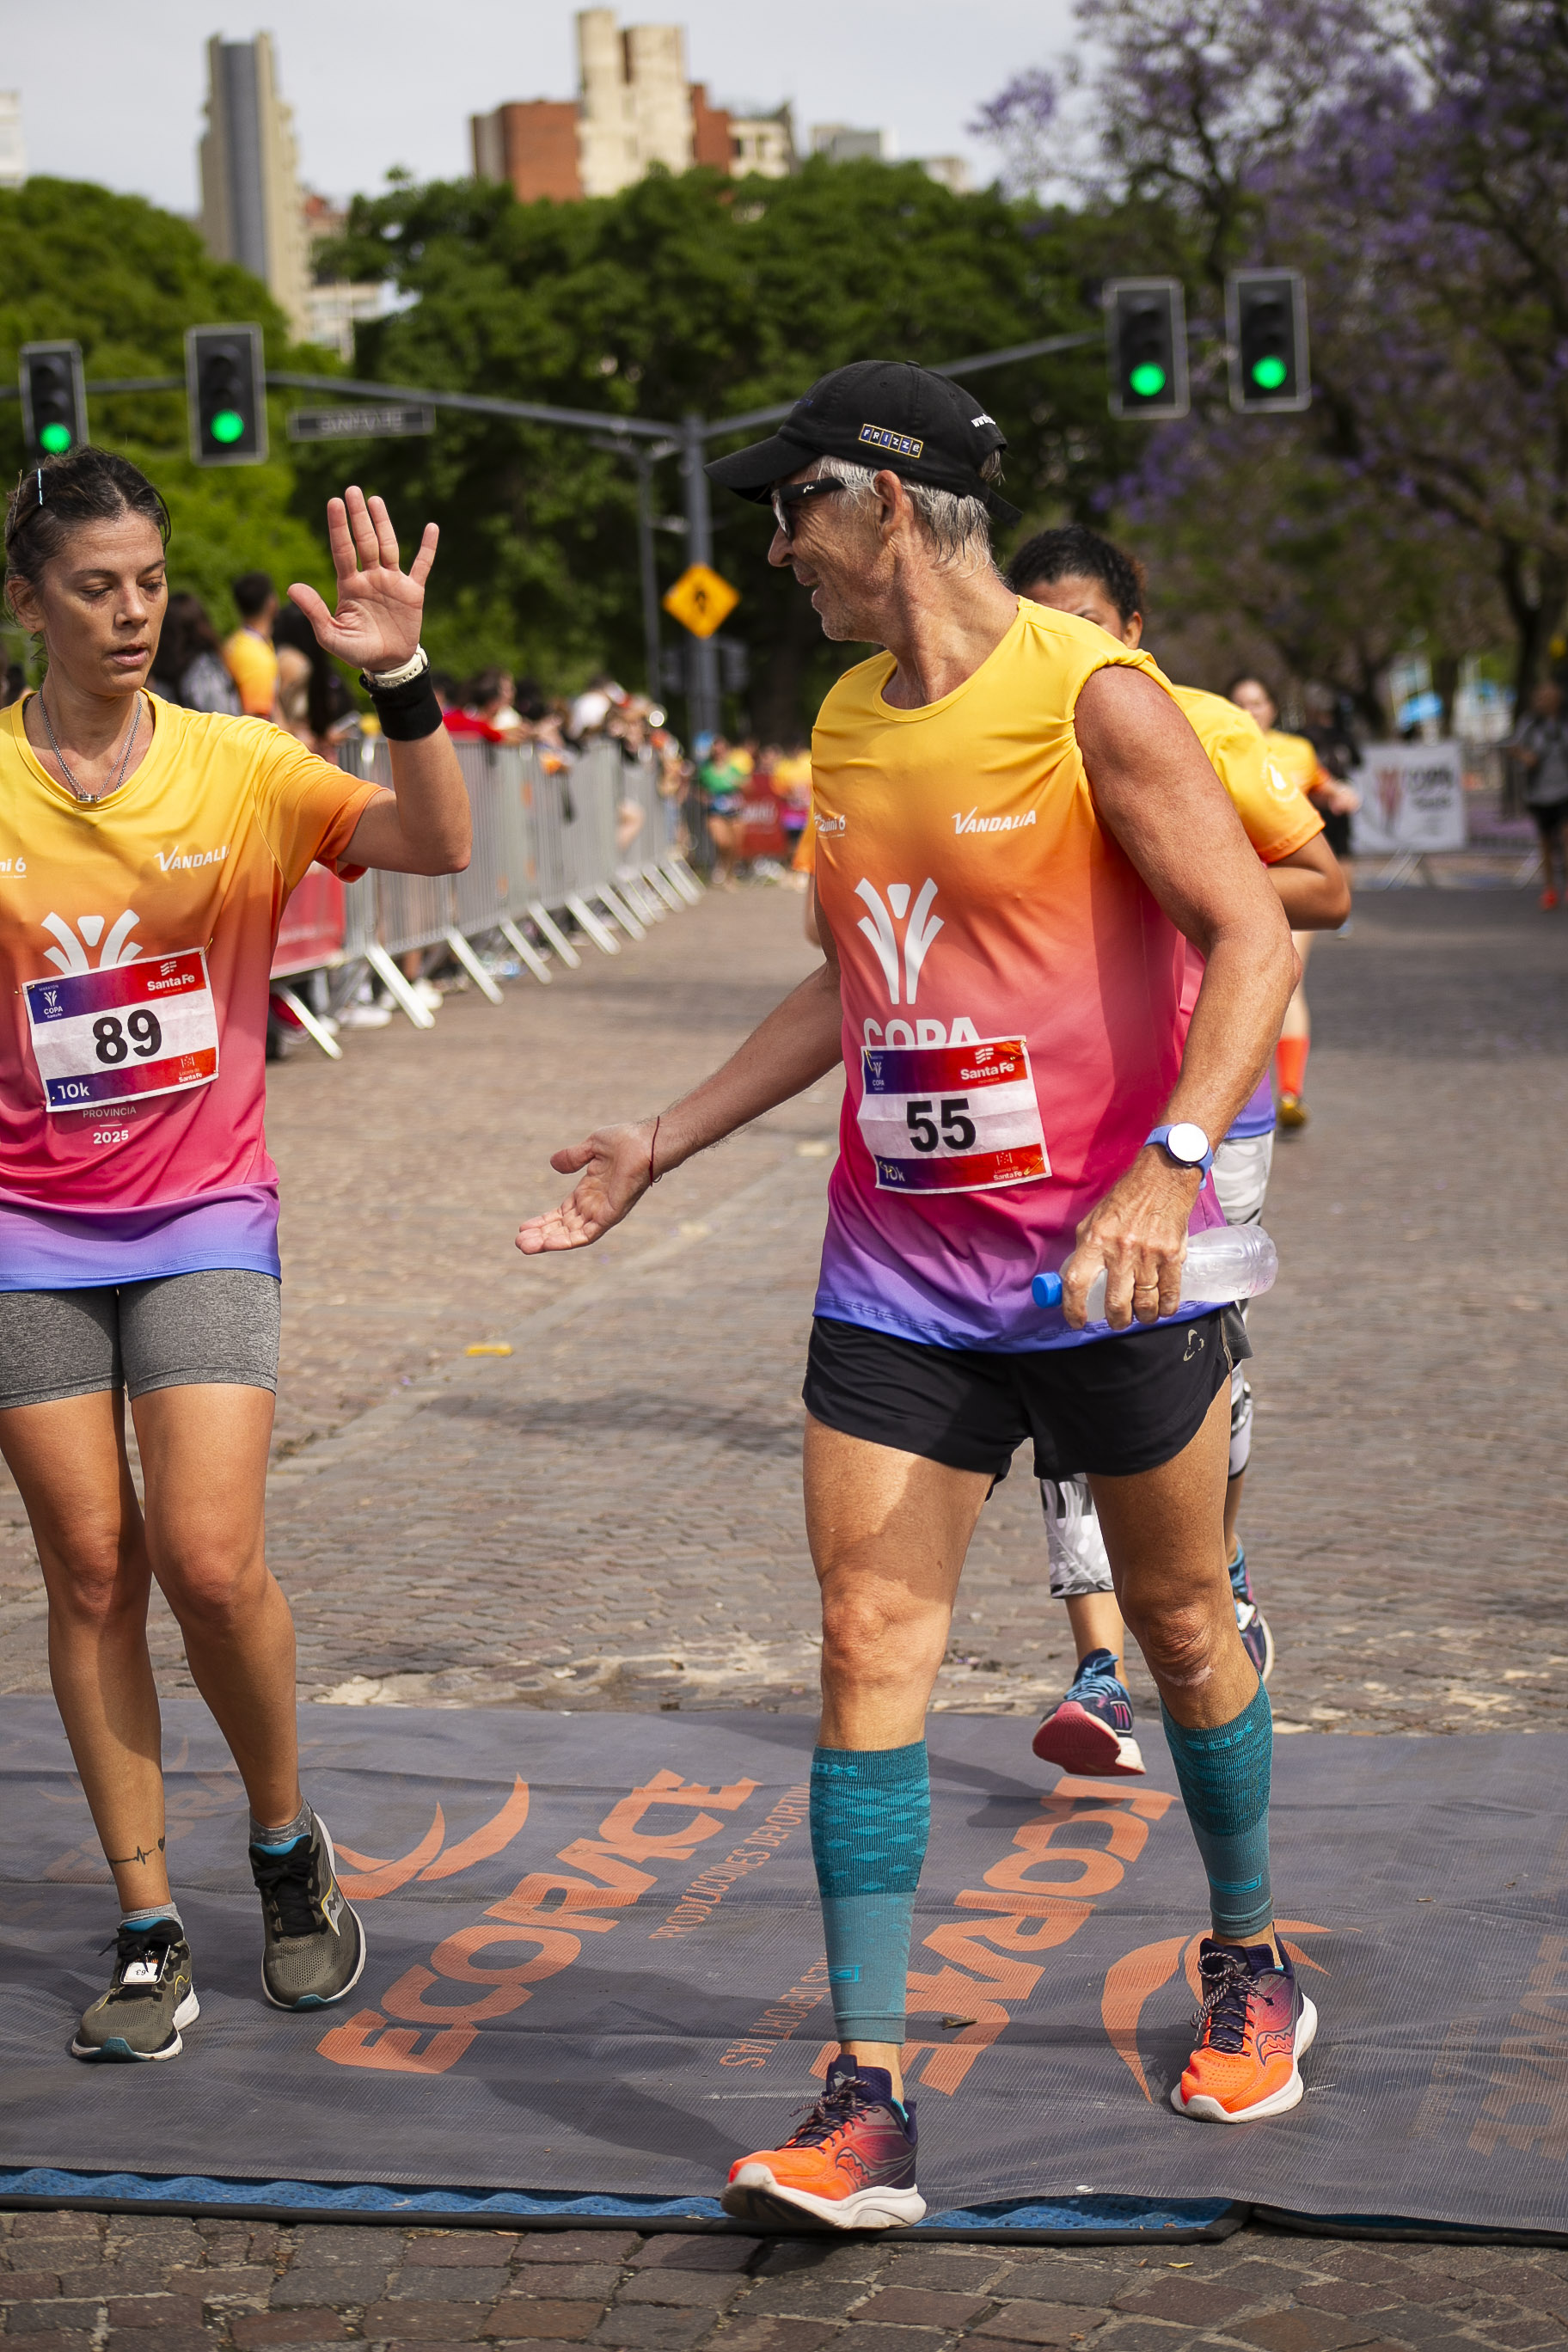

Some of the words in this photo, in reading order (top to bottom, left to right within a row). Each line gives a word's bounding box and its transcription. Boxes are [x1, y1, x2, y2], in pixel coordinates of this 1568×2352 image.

[838, 813, 847, 831] 6
[951, 805, 1037, 835] VANDALIA
[15, 856, 27, 873] 6
[147, 977, 181, 991] Santa
[181, 973, 195, 984] Fe
[44, 1006, 63, 1015] COPA
[92, 1008, 162, 1064] 89
[179, 1075, 196, 1083] Santa
[960, 1066, 999, 1080] Santa
[999, 1062, 1014, 1074] Fe
[57, 1082, 90, 1099] 10k
[83, 1106, 137, 1118] PROVINCIA
[906, 1098, 977, 1153] 55
[93, 1130, 129, 1144] 2025
[993, 1173, 1014, 1181] Santa
